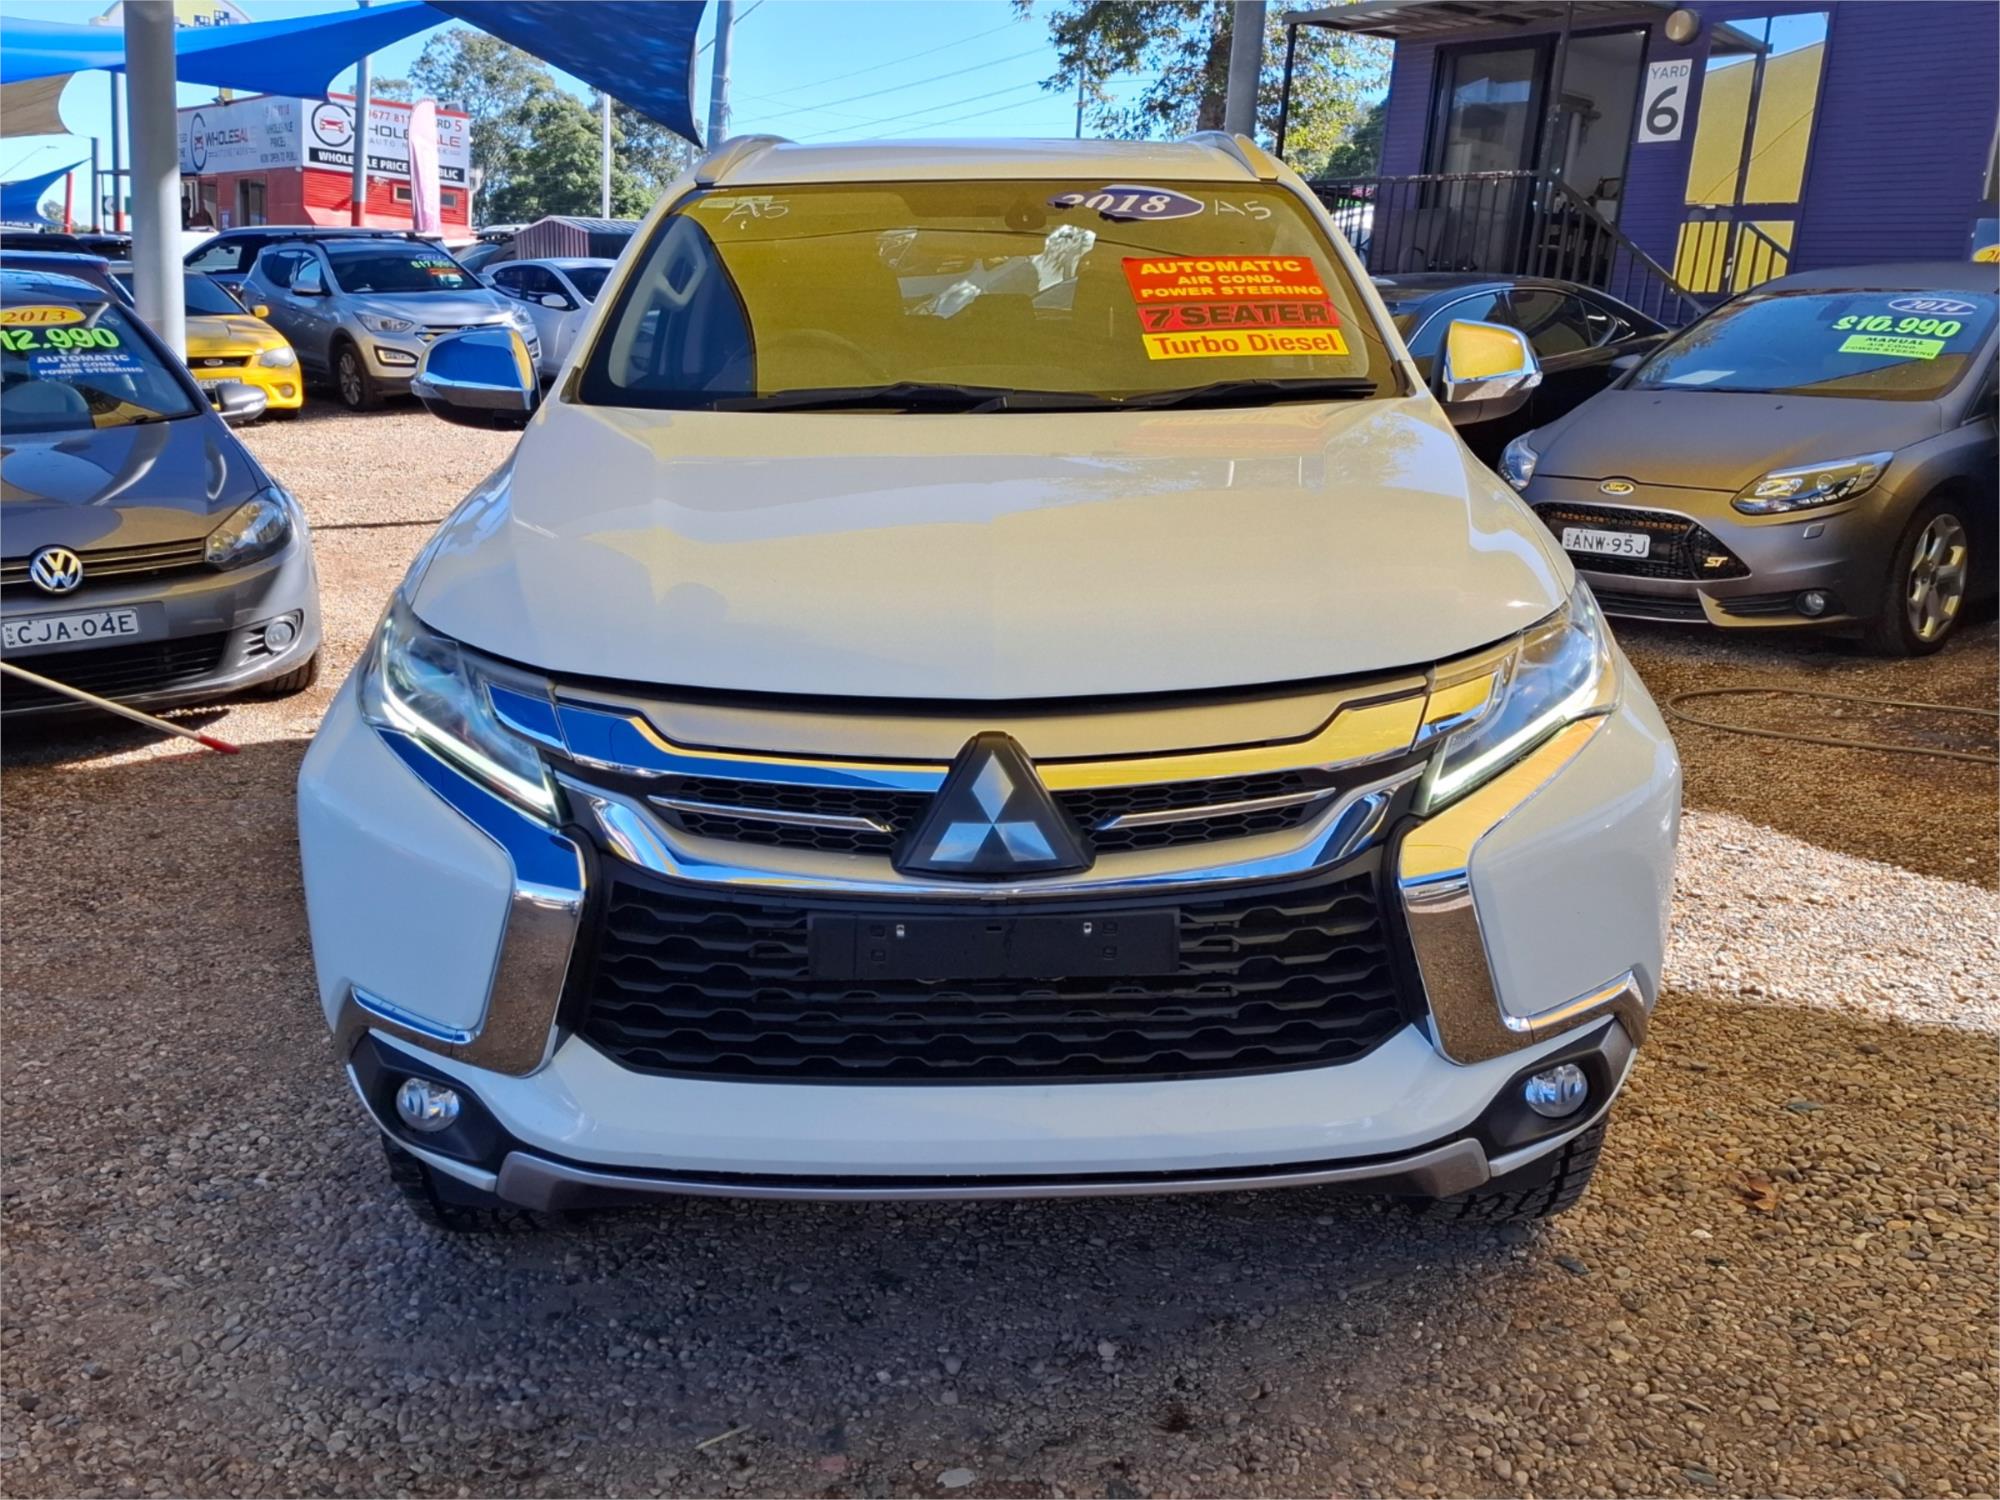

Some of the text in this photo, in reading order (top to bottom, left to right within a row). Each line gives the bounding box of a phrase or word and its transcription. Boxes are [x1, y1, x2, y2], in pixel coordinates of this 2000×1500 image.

[1651, 65, 1690, 79] YARD
[1646, 85, 1679, 136] 6
[455, 120, 462, 132] 5
[380, 160, 408, 173] PRICE
[1058, 194, 1171, 213] 2018
[1140, 260, 1303, 275] AUTOMATIC
[1178, 274, 1281, 285] AIR COND.
[1141, 285, 1323, 298] POWER STEERING
[4, 310, 67, 323] 2013
[1145, 303, 1330, 328] 7 SEATER
[1832, 315, 1961, 338] $16.990
[1153, 333, 1338, 356] Turbo Diesel
[37, 354, 130, 364] AUTOMATIC
[1704, 556, 1728, 568] ST
